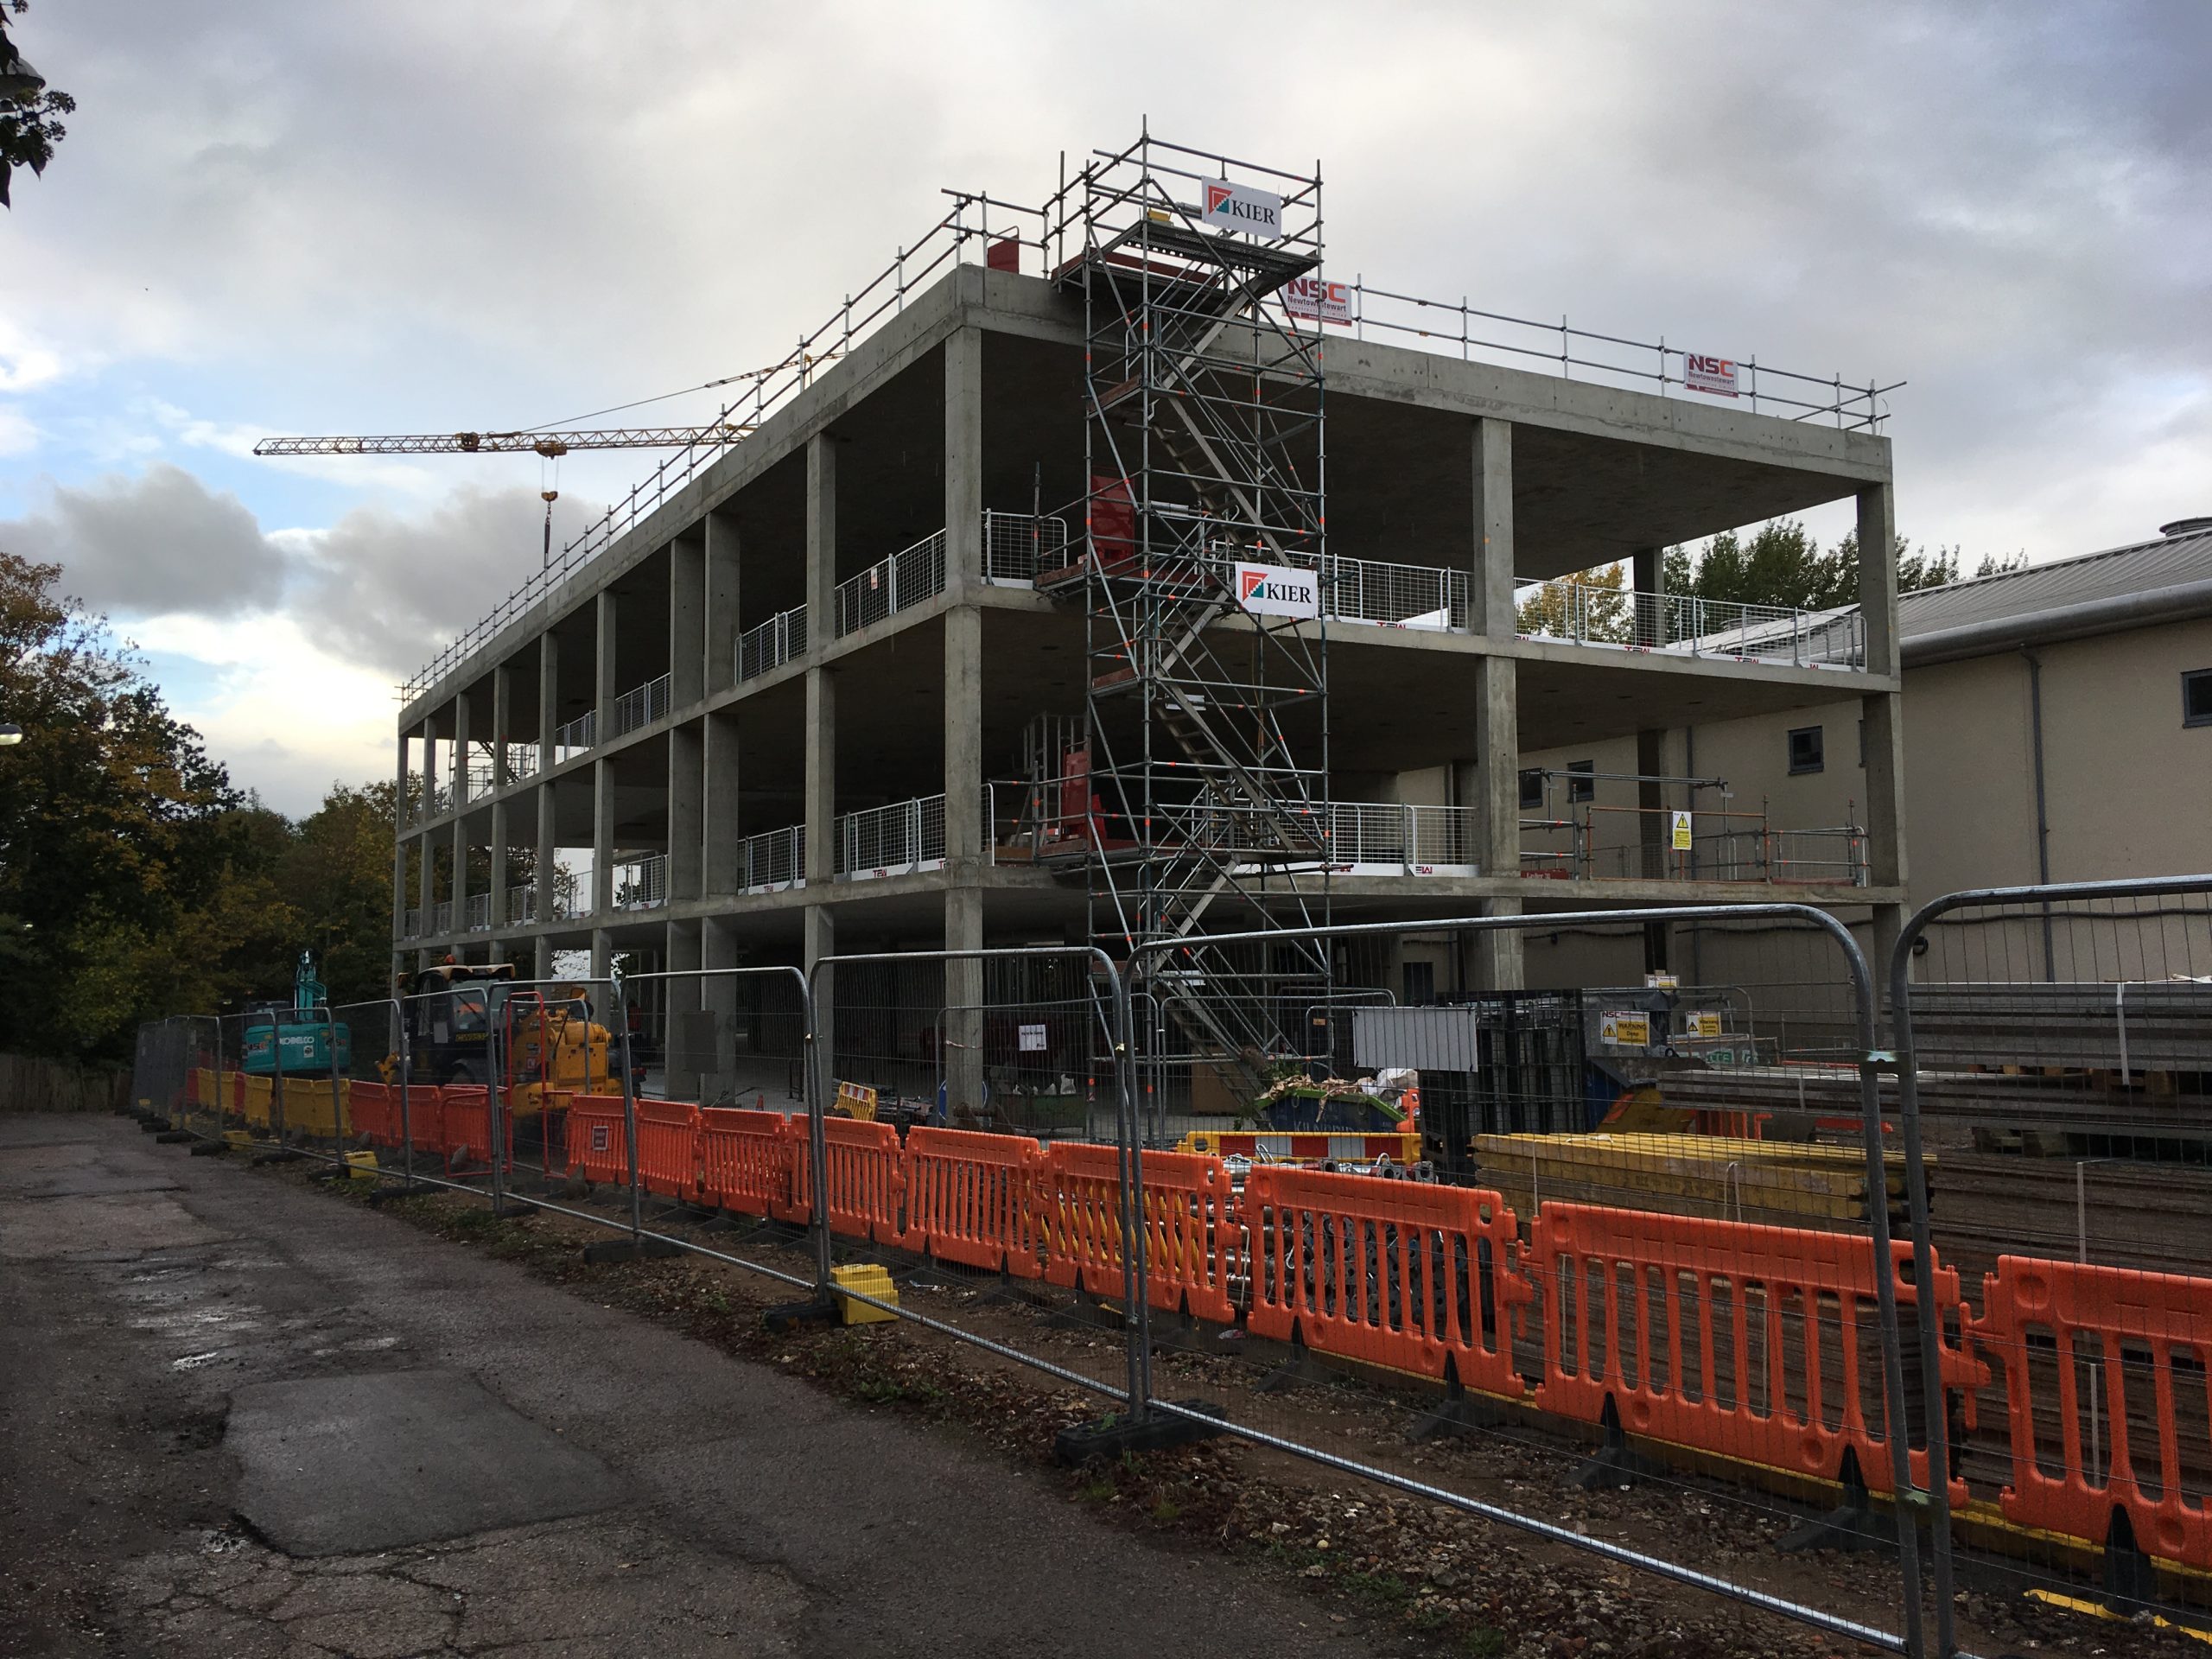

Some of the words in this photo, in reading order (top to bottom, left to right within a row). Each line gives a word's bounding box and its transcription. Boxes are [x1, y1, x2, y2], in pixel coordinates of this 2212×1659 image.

[1231, 199, 1275, 225] KIER
[1287, 278, 1345, 303] NSC
[1688, 353, 1734, 378] NSC
[1267, 582, 1312, 603] KIER
